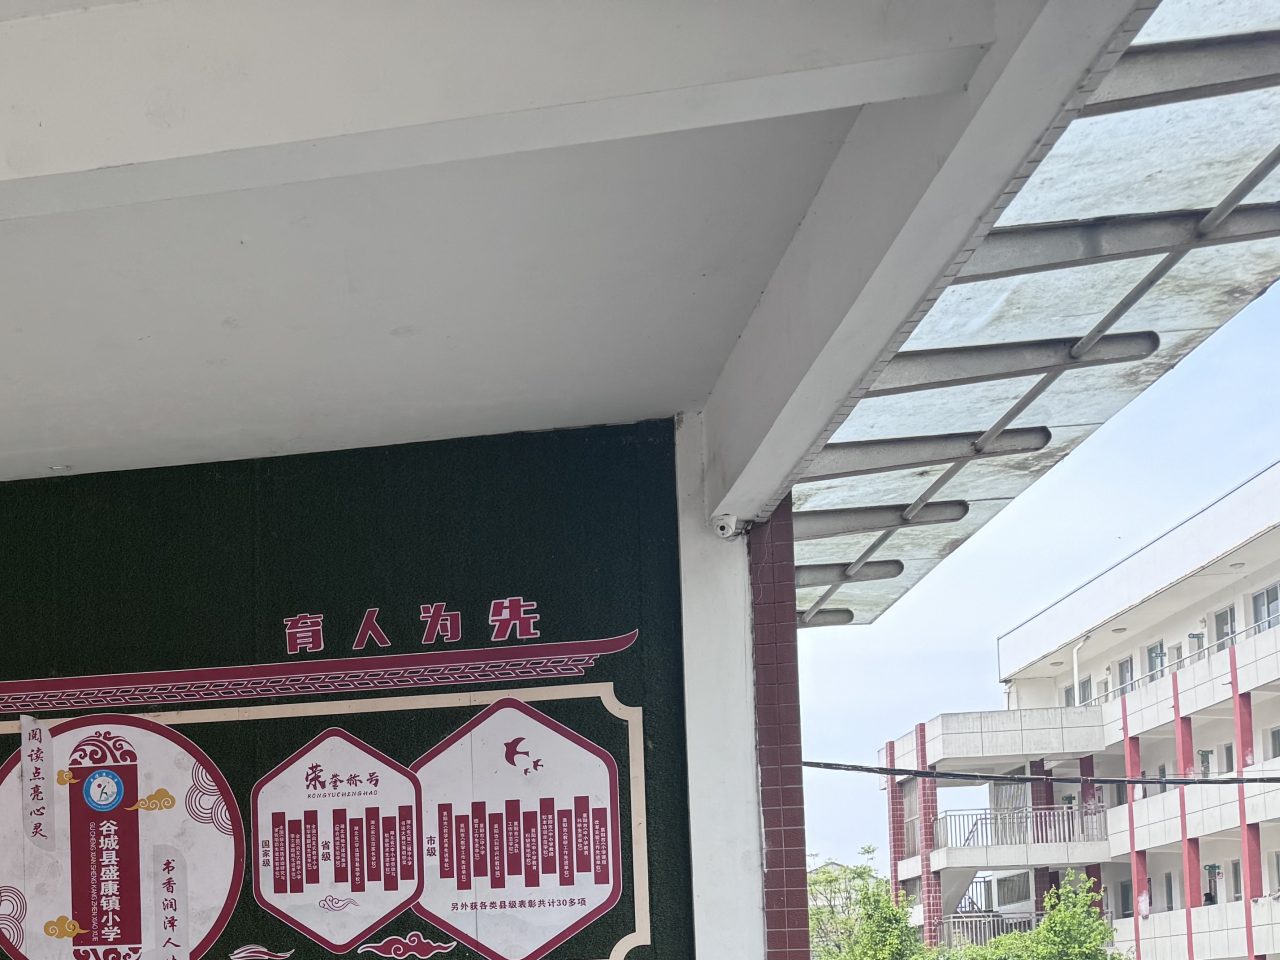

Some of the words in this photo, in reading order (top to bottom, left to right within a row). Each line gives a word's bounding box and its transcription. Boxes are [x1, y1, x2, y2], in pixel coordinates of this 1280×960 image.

[284, 597, 541, 654] 育人为先
[28, 728, 47, 838] 阅读点亮心灵
[305, 763, 379, 790] 荣誉称号
[308, 790, 377, 798] RONGYUCHENGHAO
[262, 840, 270, 866] 国家级
[321, 841, 331, 861] 省级
[426, 836, 436, 856] 市级
[98, 820, 120, 942] 谷城县盛康镇小学
[451, 898, 586, 911] 另外获各类县级表彰共计30多项
